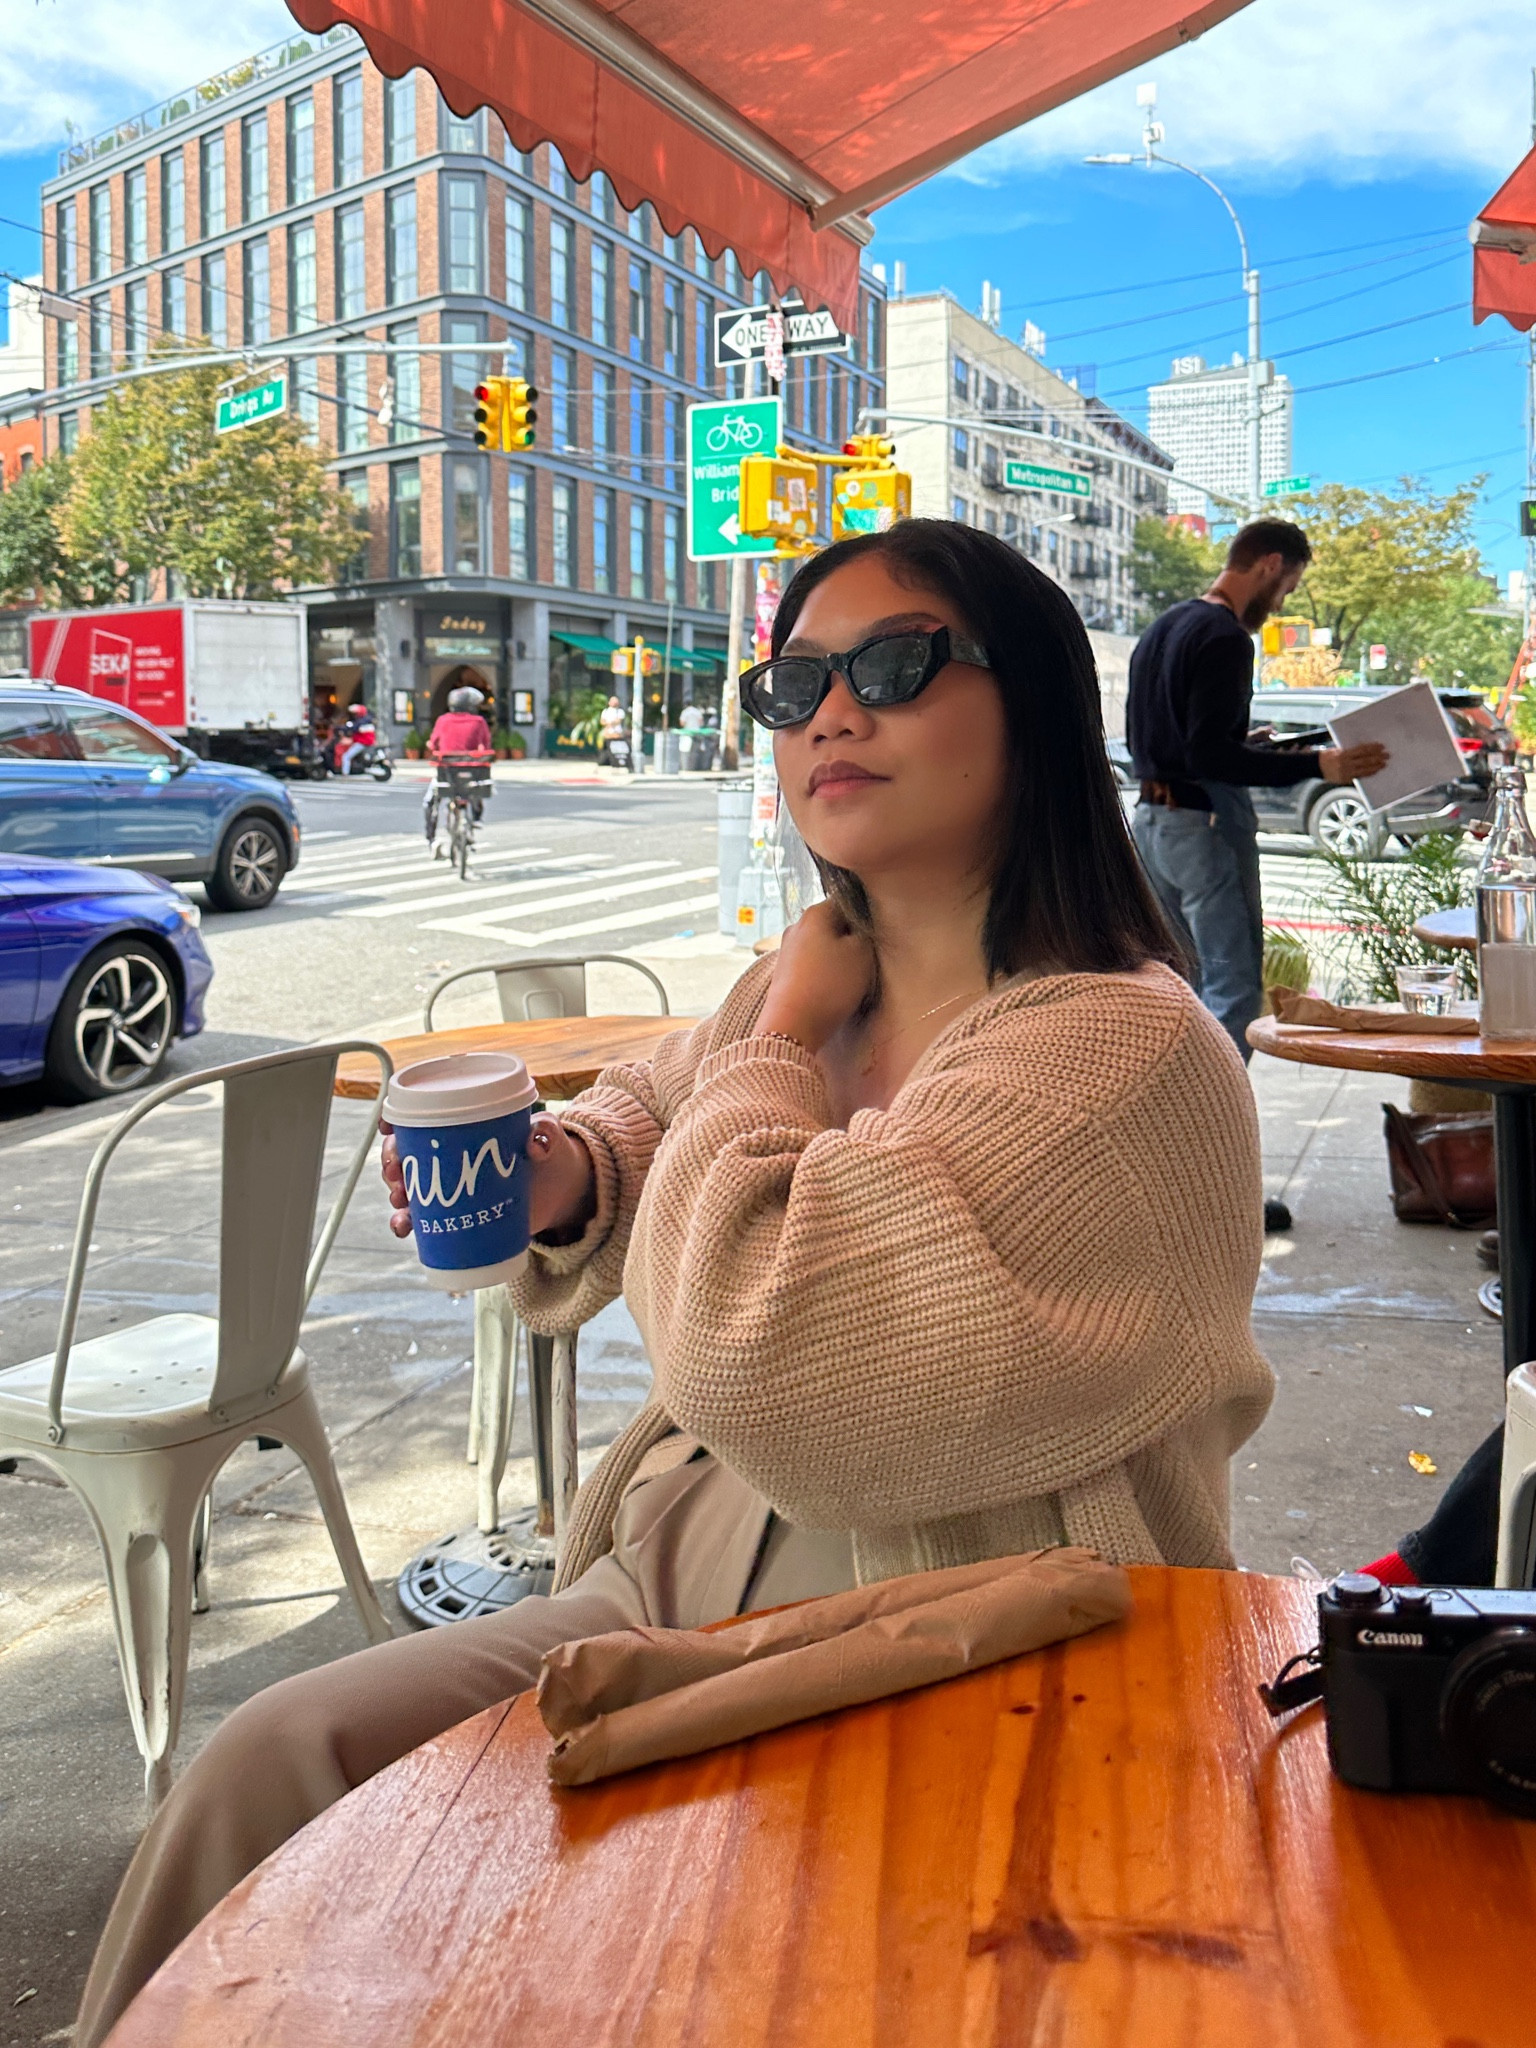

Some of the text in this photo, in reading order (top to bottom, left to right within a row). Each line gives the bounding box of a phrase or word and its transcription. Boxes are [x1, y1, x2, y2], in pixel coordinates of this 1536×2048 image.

[735, 316, 828, 346] ONE WAY
[1011, 466, 1088, 493] Metropolitan Av
[419, 1202, 505, 1234] BAKERY
[1356, 1627, 1425, 1647] Canon
